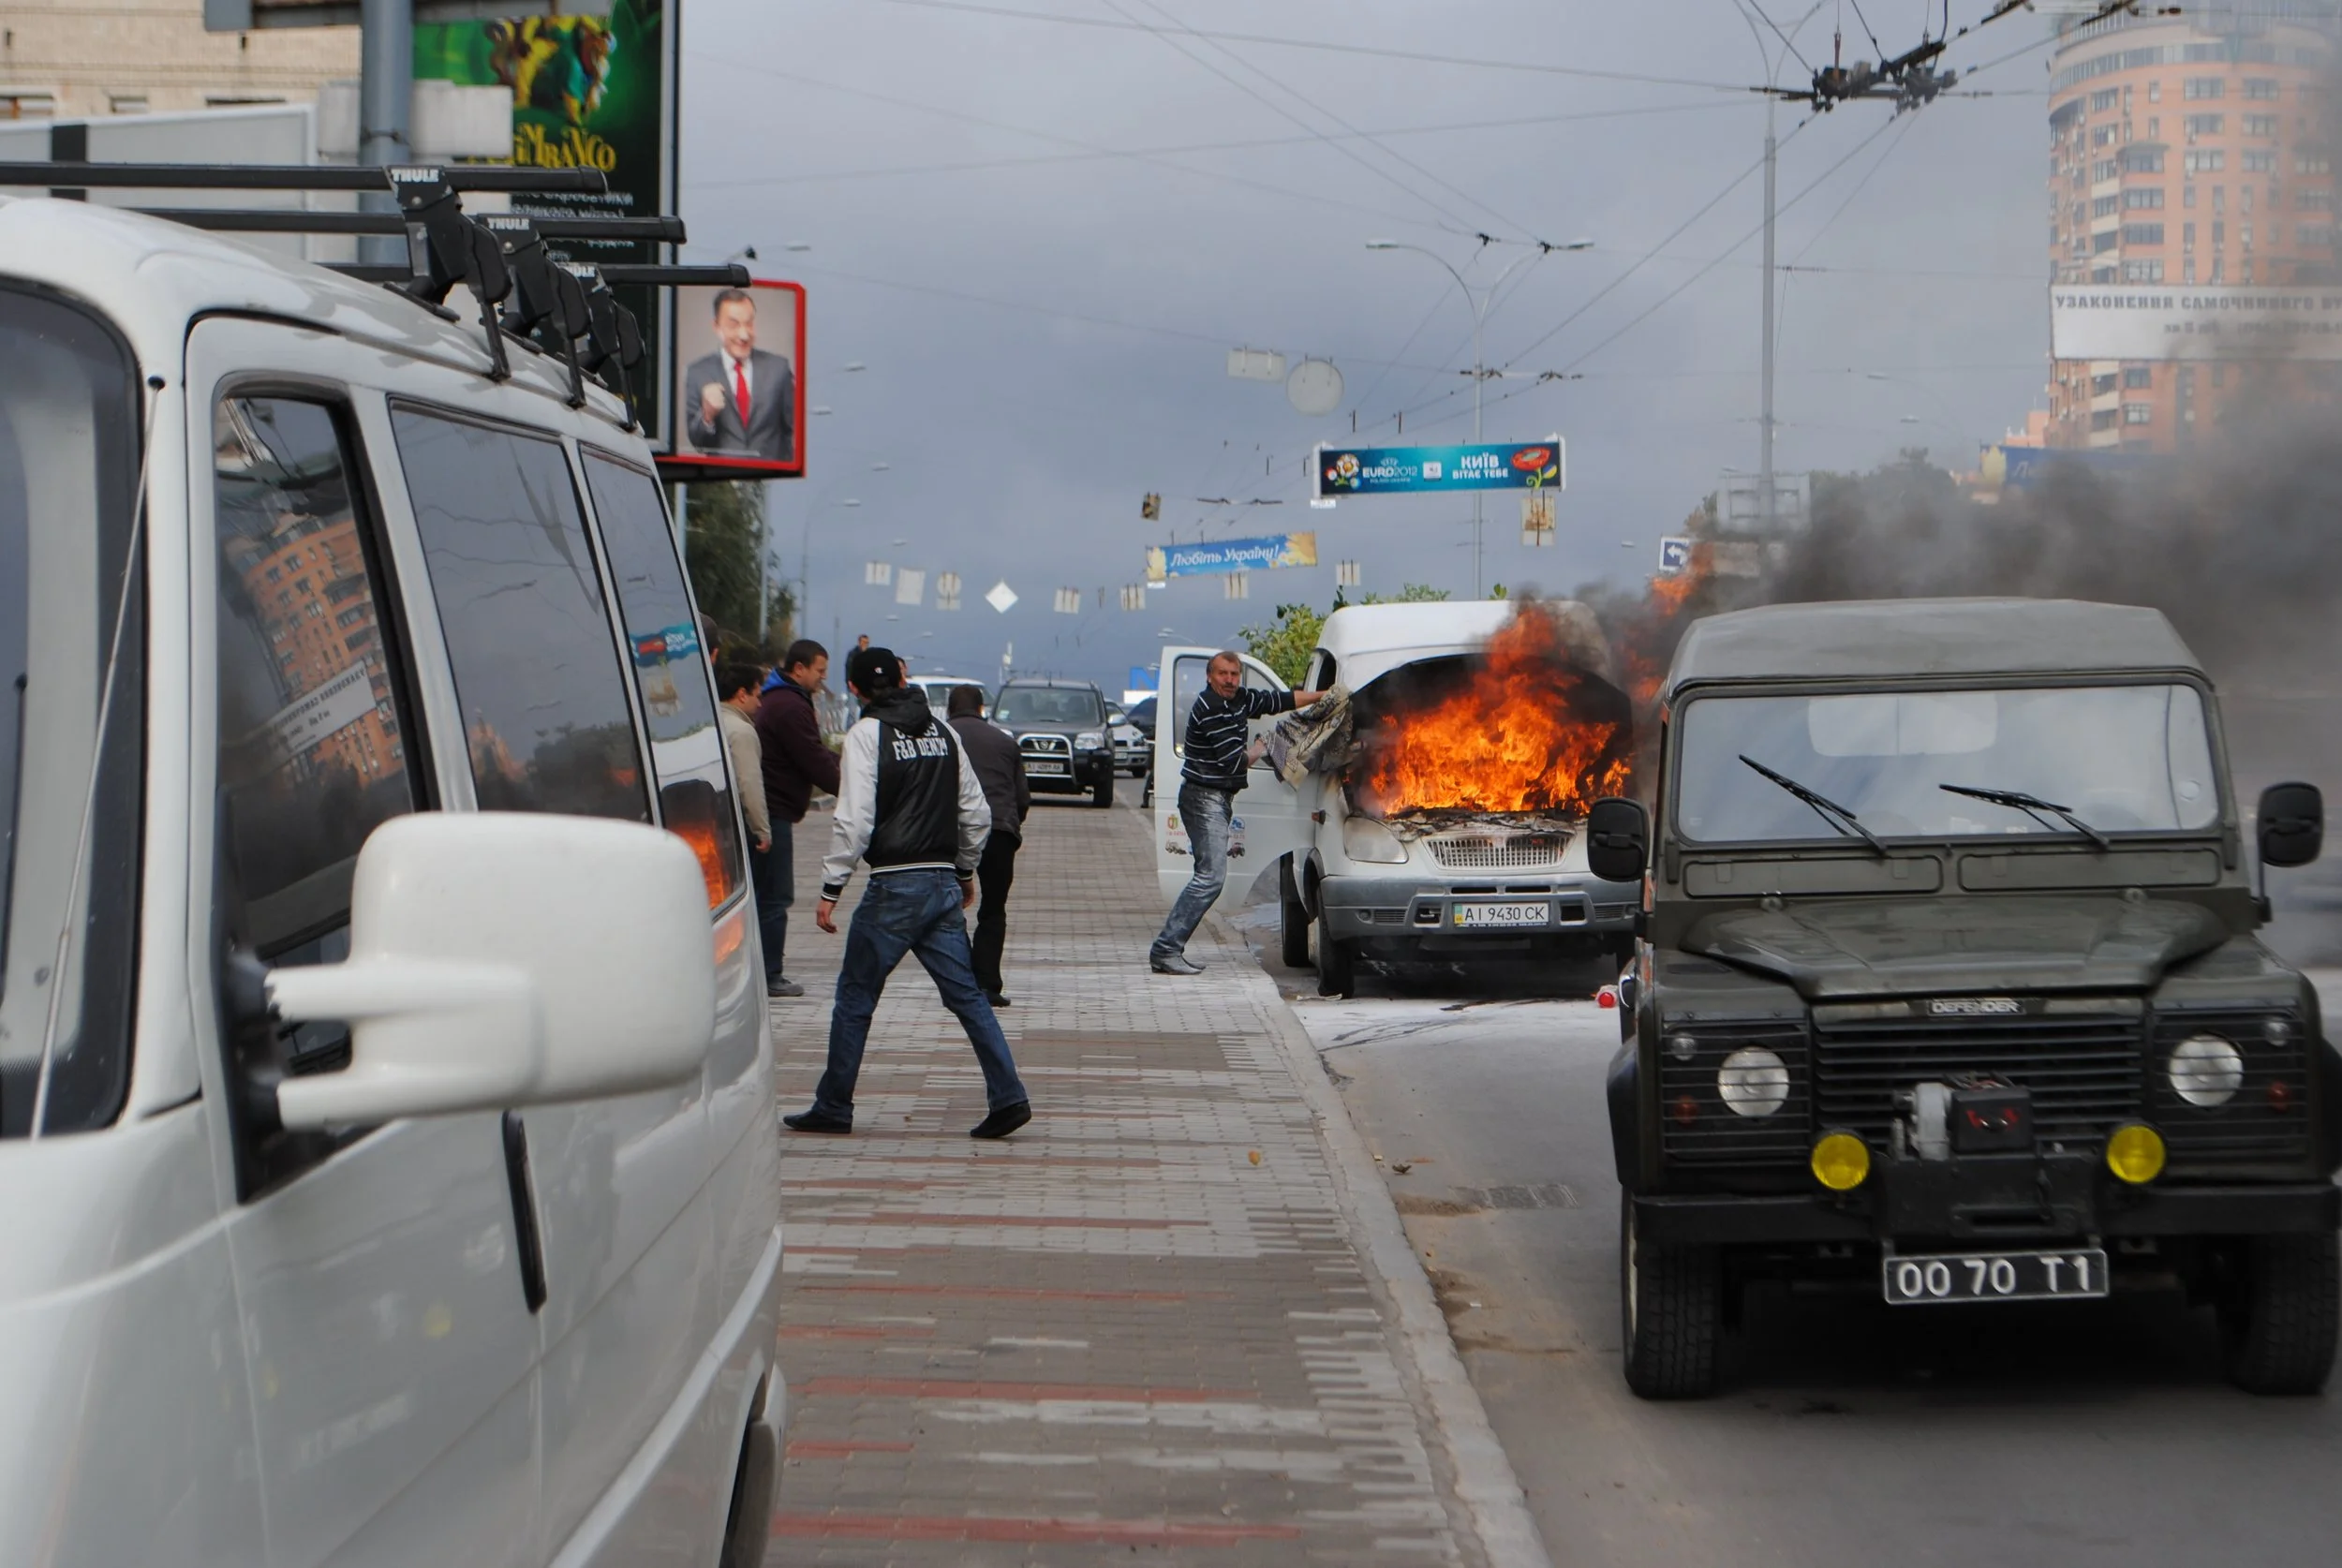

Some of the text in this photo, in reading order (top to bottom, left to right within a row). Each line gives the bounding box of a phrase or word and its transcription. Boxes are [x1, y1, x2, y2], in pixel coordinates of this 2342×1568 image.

[392, 169, 439, 183] THULE
[487, 217, 529, 230] THULE
[564, 265, 595, 278] HULE
[1460, 451, 1499, 469] КИЇВ
[1362, 466, 1417, 478] EURO2012
[1171, 545, 1280, 566] Любіть Україну!
[1465, 907, 1545, 921] AI 9430 CK
[1963, 1259, 2015, 1294] 70
[2039, 1256, 2089, 1292] T1
